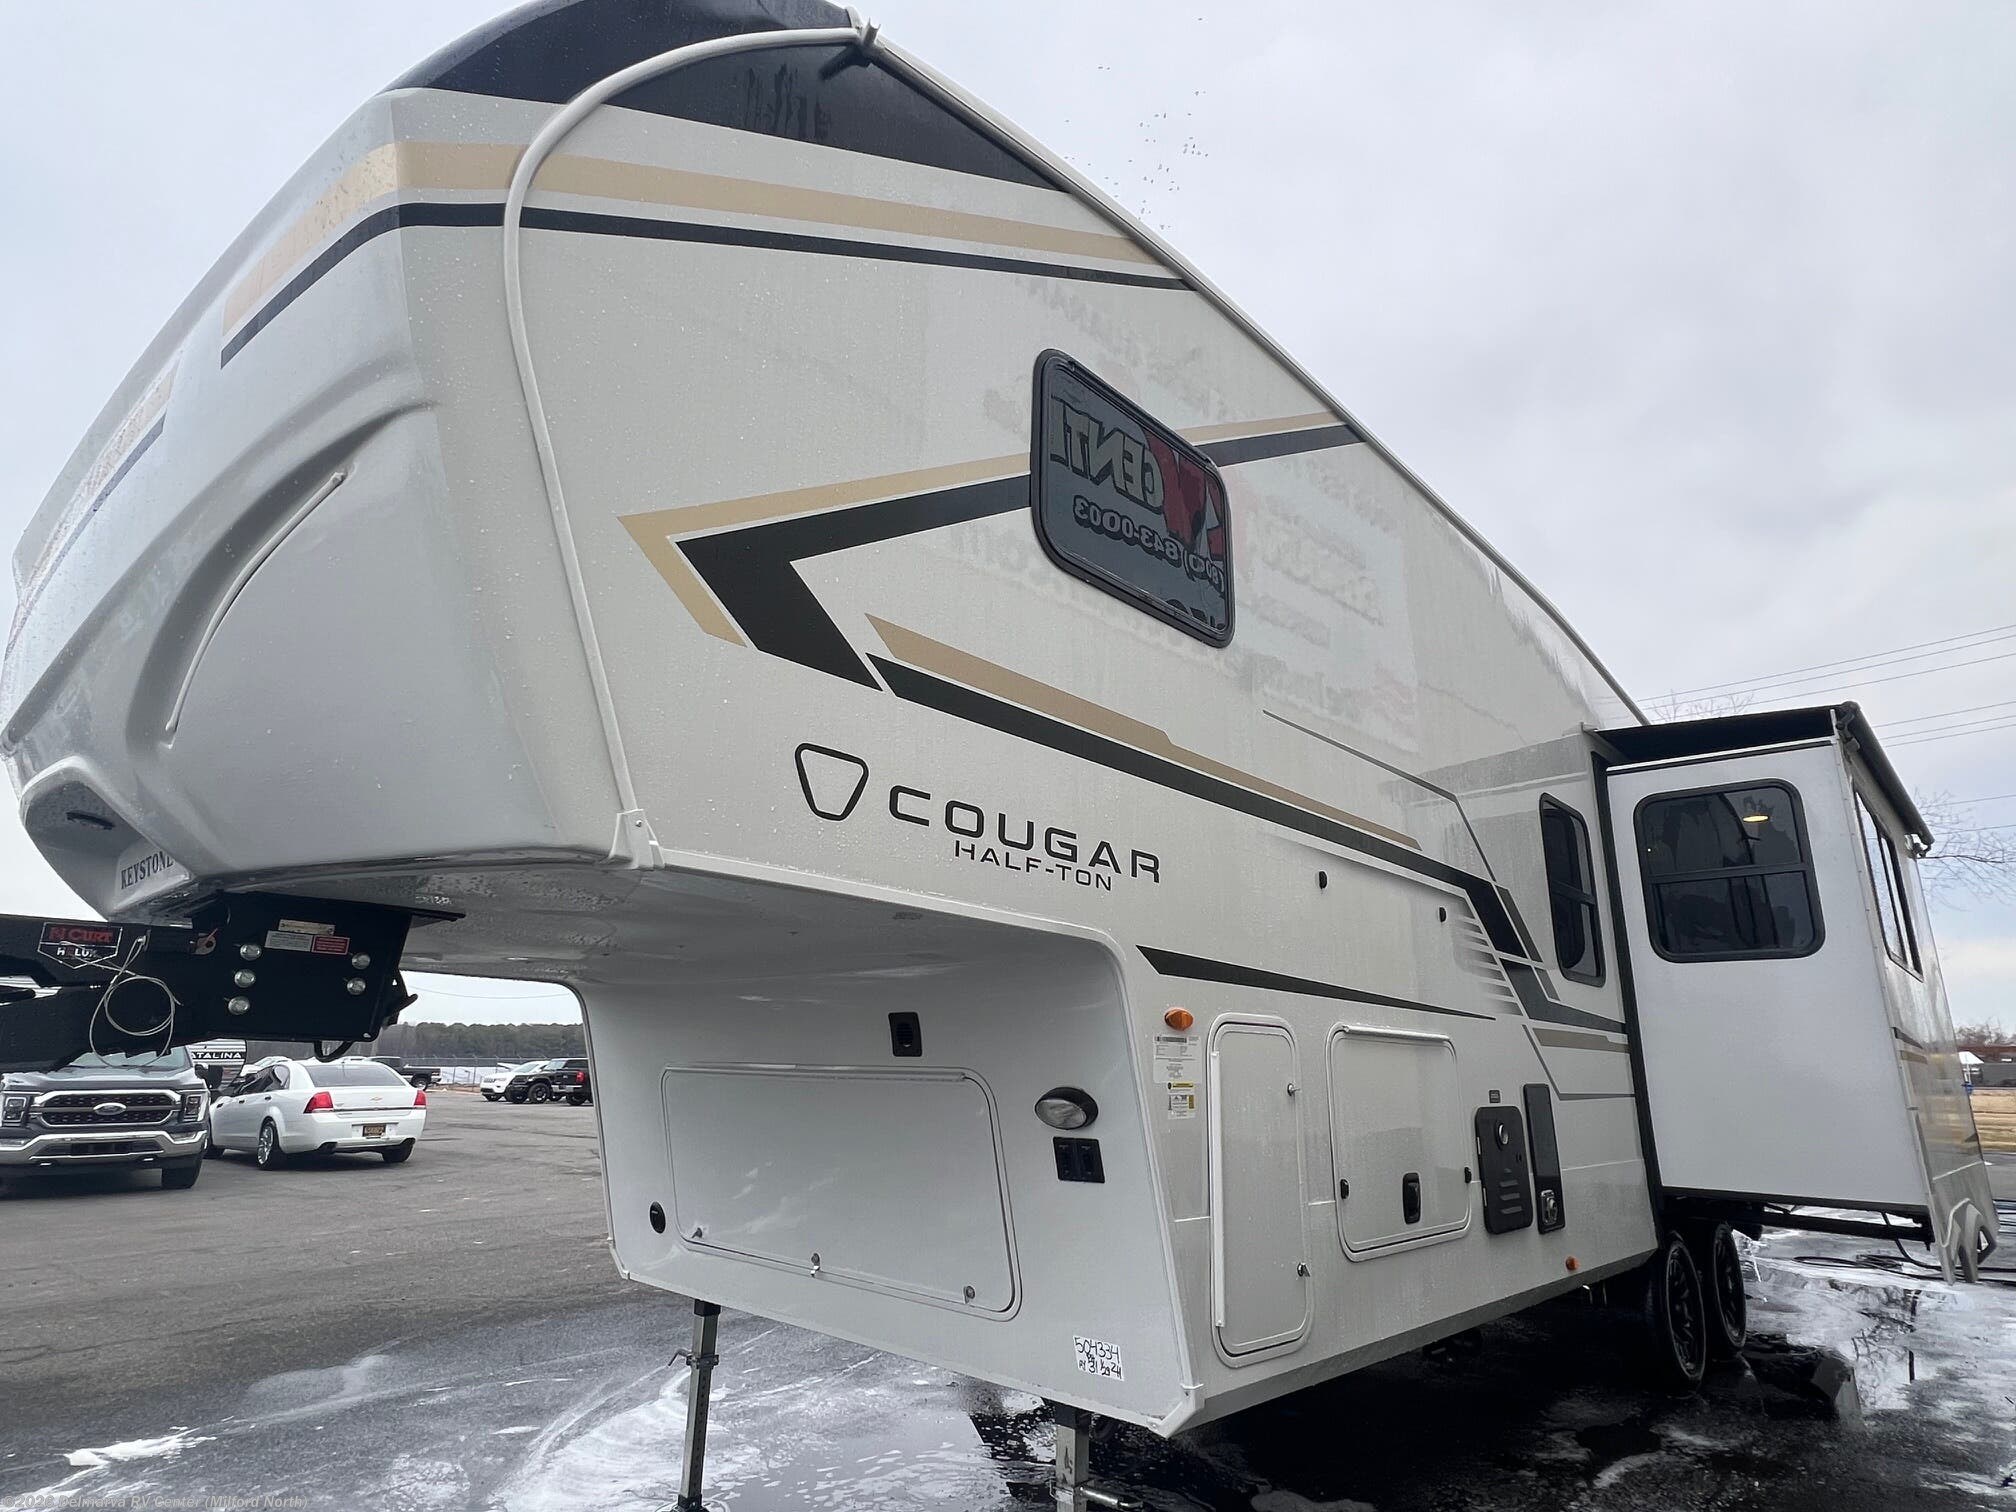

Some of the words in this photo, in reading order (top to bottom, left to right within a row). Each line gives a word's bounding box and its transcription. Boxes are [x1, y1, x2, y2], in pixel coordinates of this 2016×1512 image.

[889, 785, 1160, 883] COUGAR
[955, 840, 1111, 891] HALF-TON
[1074, 1337, 1120, 1364] 504334
